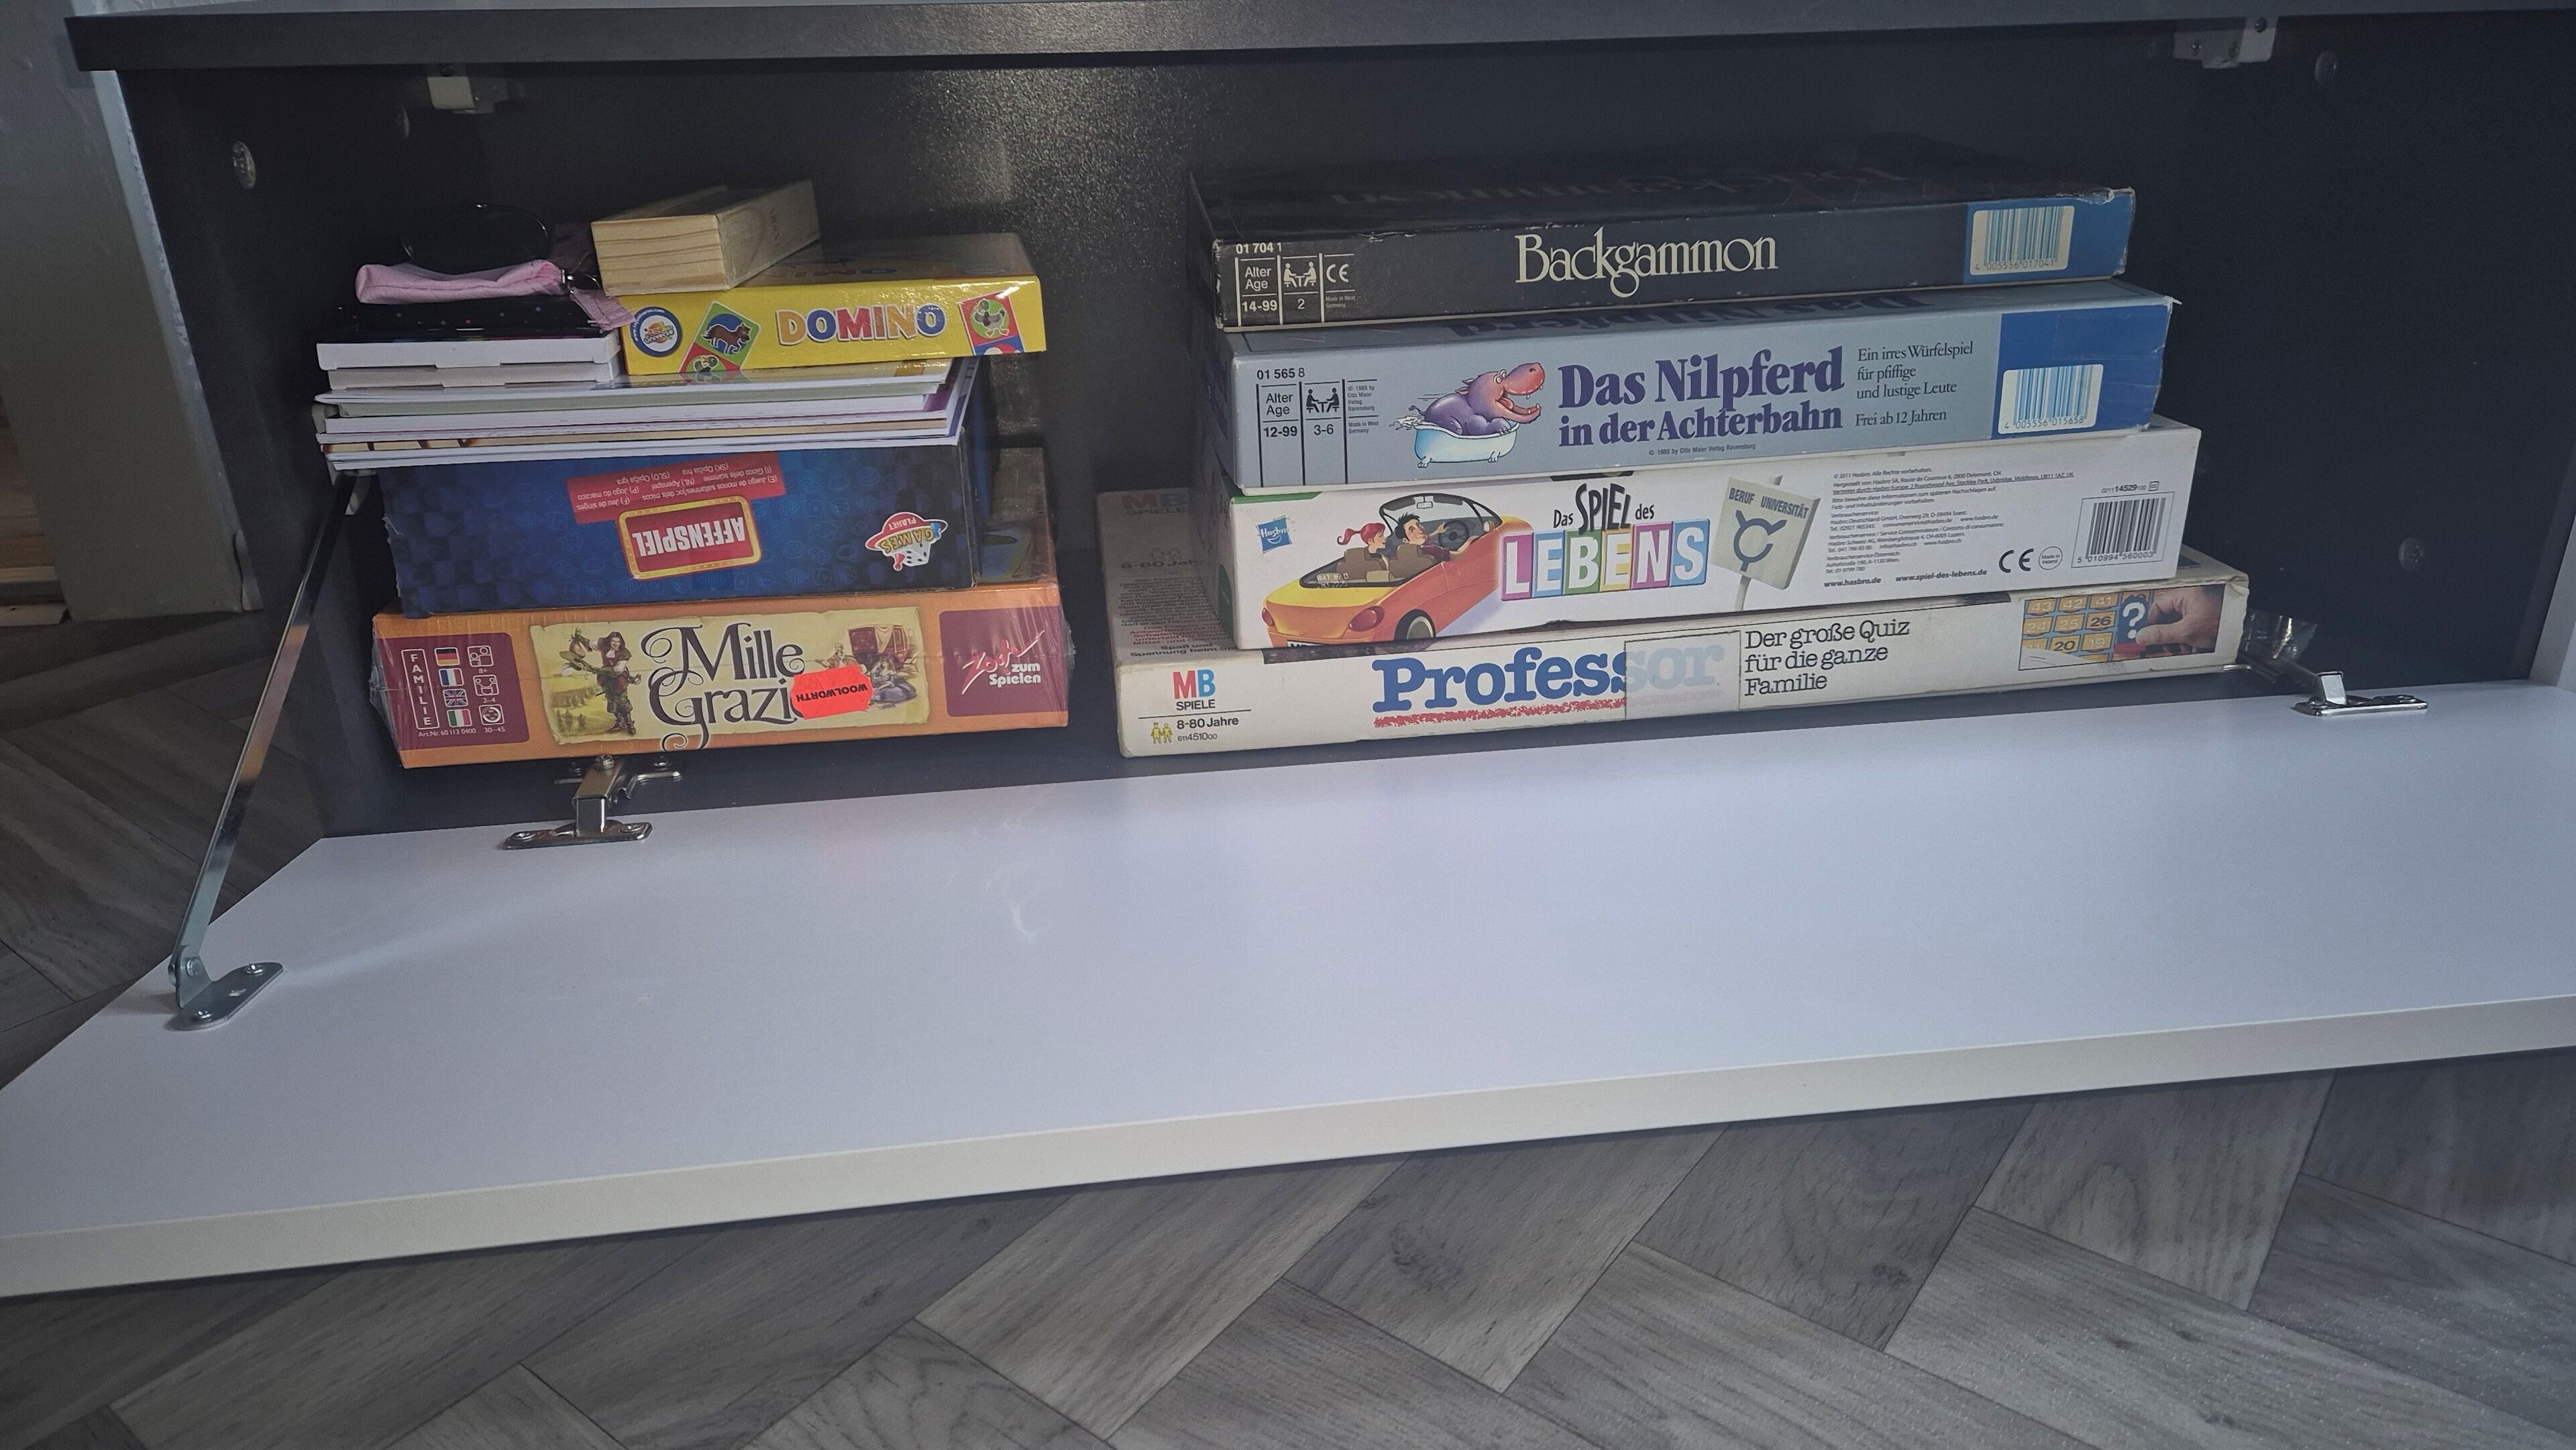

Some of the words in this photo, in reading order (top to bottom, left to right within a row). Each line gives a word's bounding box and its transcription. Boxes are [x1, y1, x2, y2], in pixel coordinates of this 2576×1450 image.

[1236, 244, 1248, 254] 01
[1252, 243, 1274, 253] 704
[1277, 242, 1282, 252] 1
[1515, 226, 1778, 297] Backgammon
[1986, 261, 2019, 270] 005556
[2023, 259, 2054, 268] 017041
[1244, 266, 1272, 278] Alter
[1245, 278, 1268, 291] Age
[1242, 300, 1278, 312] 14-99
[1297, 299, 1305, 309] 2
[776, 303, 947, 346] DOMINO
[1858, 348, 1878, 361] Ein
[1882, 347, 1907, 360] irres
[1908, 341, 1974, 359] Würfelspiel
[1256, 370, 1269, 380] 01
[1274, 368, 1295, 378] 565
[1298, 368, 1305, 378] 8
[1558, 364, 1646, 409] Das
[1654, 345, 1845, 412] Nilpferd
[1857, 366, 1874, 380] für
[1876, 364, 1917, 383] pfiffige
[1266, 393, 1293, 403] Alter
[1857, 385, 1880, 399] und
[1883, 383, 1921, 399] lustige
[1923, 382, 1957, 395] Leute
[1267, 405, 1290, 417] Age
[1855, 413, 1877, 426] Frei
[1880, 411, 1894, 424] ab
[1896, 411, 1908, 423] 12
[1908, 409, 1947, 425] Jahren
[1313, 424, 1334, 435] 3-6
[1558, 415, 1595, 446] in
[1599, 413, 1656, 444] der
[1656, 399, 1843, 442] Achterbahn
[2015, 420, 2047, 429] 005556
[2051, 416, 2084, 425] 015658
[1263, 426, 1297, 437] 12-99
[1553, 509, 1574, 528] Das
[1575, 482, 1631, 535] SPIEL
[1634, 503, 1655, 521] des
[1729, 487, 1756, 505] BERUF
[1761, 495, 1809, 519] UNIVERSITÄT
[888, 517, 917, 530] PLANET
[631, 517, 745, 557] AFFENSPIEL
[1260, 527, 1289, 538] Hasbro
[880, 528, 934, 554] GAMES
[1503, 525, 1707, 599] LEBENS
[2088, 554, 2118, 562] 010994
[2122, 551, 2153, 560] 560003
[1824, 577, 1882, 587] www.hasbro.de
[1896, 568, 1987, 582] www.spiel-des-lebens.de
[2031, 601, 2052, 611] 43
[2063, 599, 2082, 609] 42
[2096, 596, 2111, 606] 41
[2027, 621, 2046, 631] 24
[2059, 619, 2078, 630] 25
[2090, 616, 2111, 627] 26
[1744, 630, 1787, 649] Der
[1789, 623, 1855, 650] große
[1859, 619, 1911, 643] Quiz
[2054, 641, 2076, 651] 20
[2089, 637, 2104, 648] 19
[641, 623, 805, 696] Mille
[1744, 654, 1782, 673] für
[1784, 651, 1818, 669] die
[1821, 646, 1888, 670] ganze
[1012, 662, 1040, 673] zum
[989, 673, 1041, 688] Spielen
[1173, 669, 1216, 699] MB
[1371, 644, 1725, 713] Professor
[1744, 673, 1827, 696] Familie
[410, 654, 433, 725] FAMILIE
[796, 683, 868, 703] WOOLWORTH
[649, 667, 804, 751] Grazi
[1176, 699, 1216, 711] SPIELE
[1177, 718, 1205, 729] 8-80
[1207, 717, 1239, 727] Jahre
